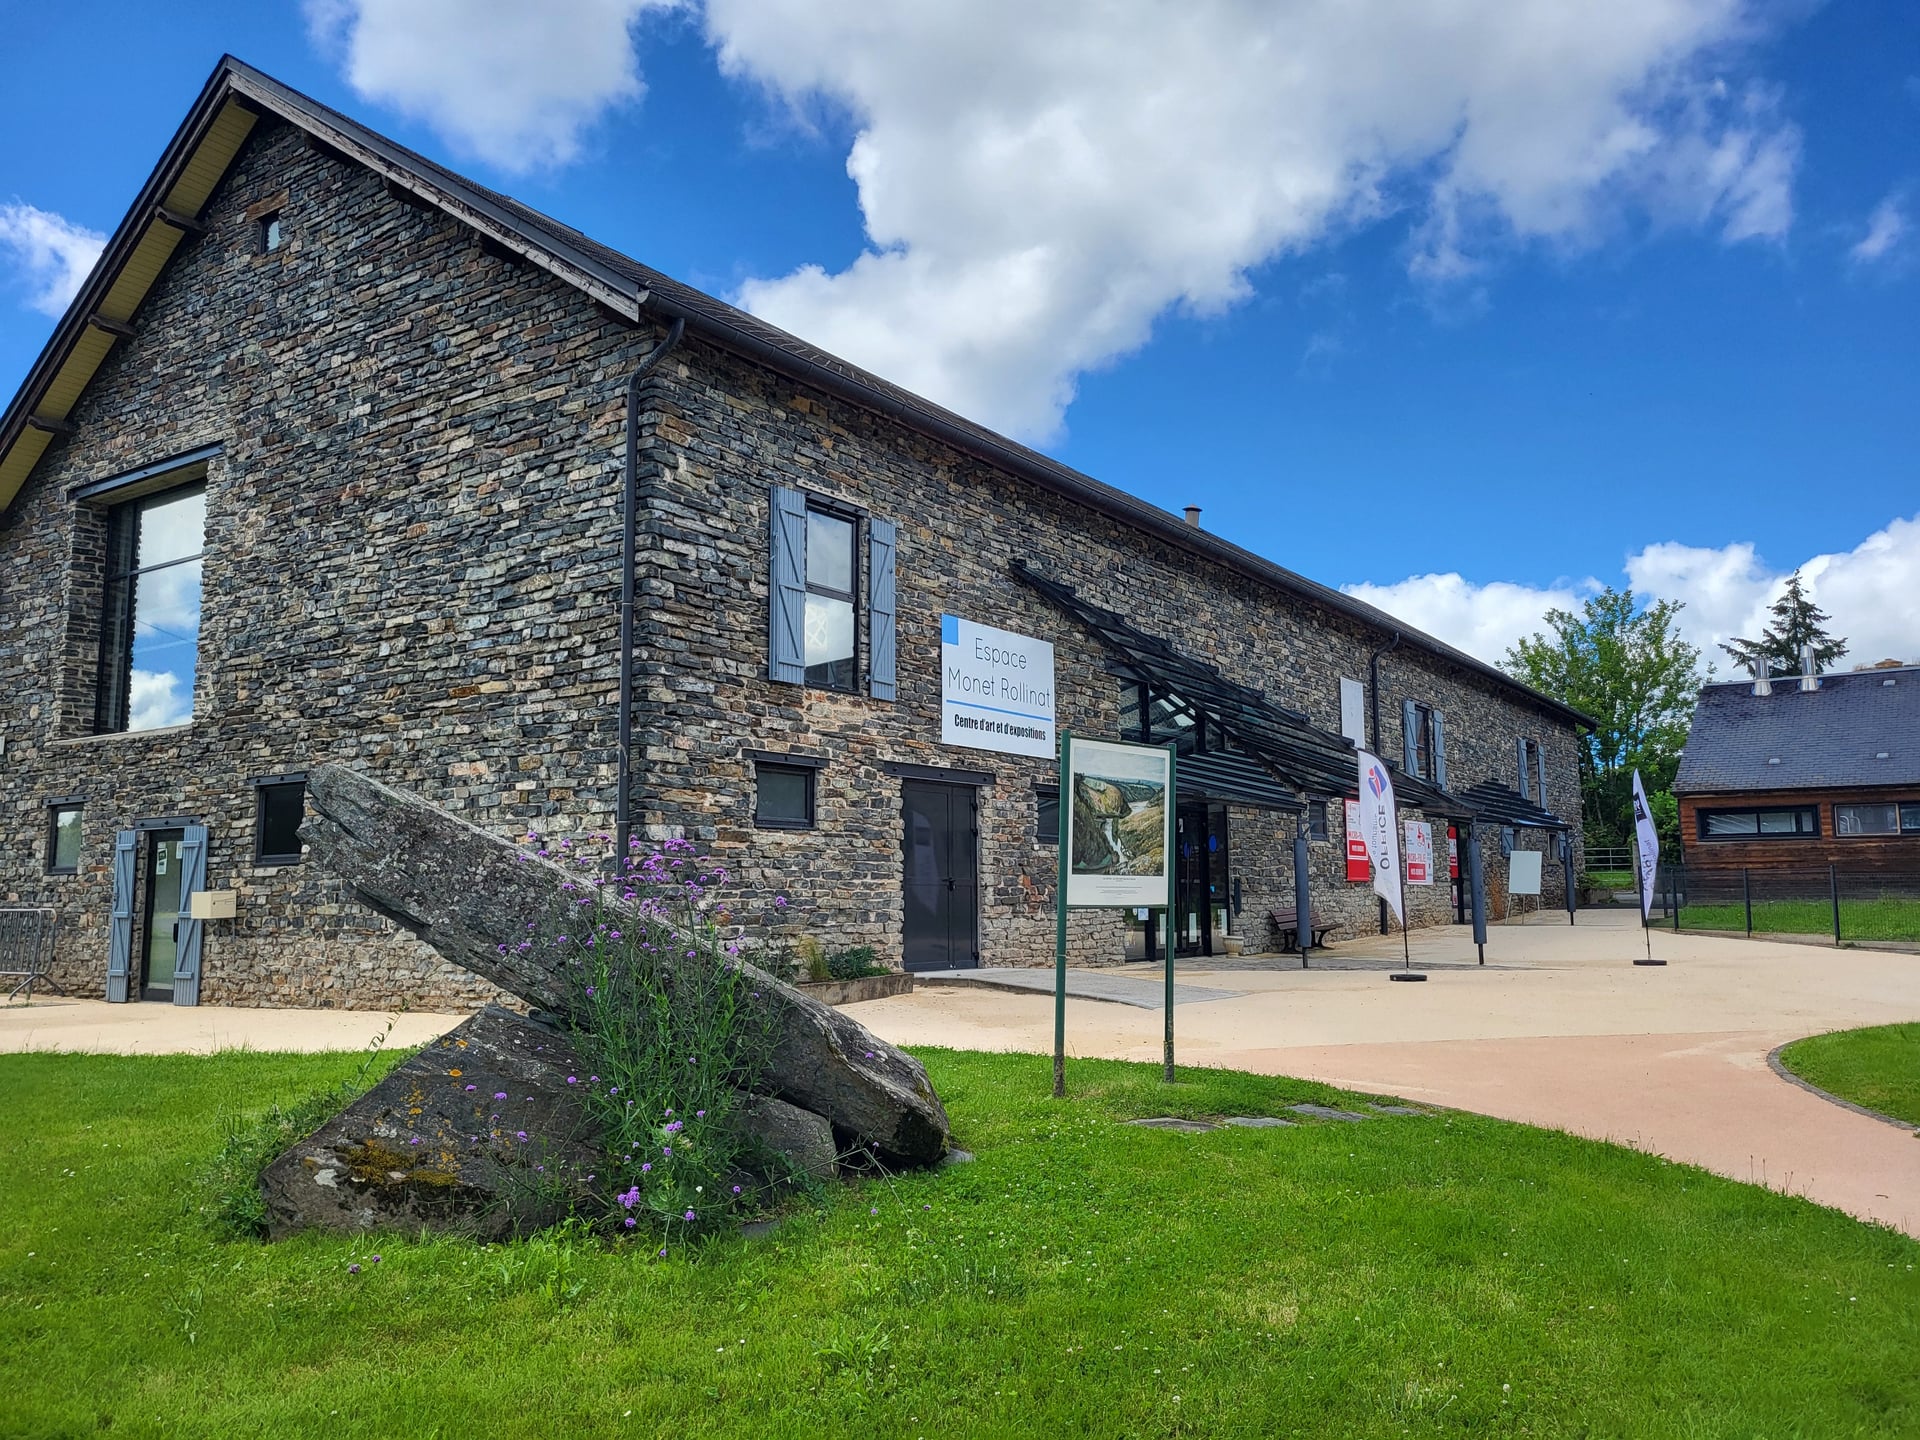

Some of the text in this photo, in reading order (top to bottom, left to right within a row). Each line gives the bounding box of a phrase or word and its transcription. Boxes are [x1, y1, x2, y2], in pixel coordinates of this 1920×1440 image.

[975, 637, 1027, 669] Espace
[948, 666, 1050, 708] Monet Rollinat
[954, 713, 1046, 741] Centre d'art et d'expositions
